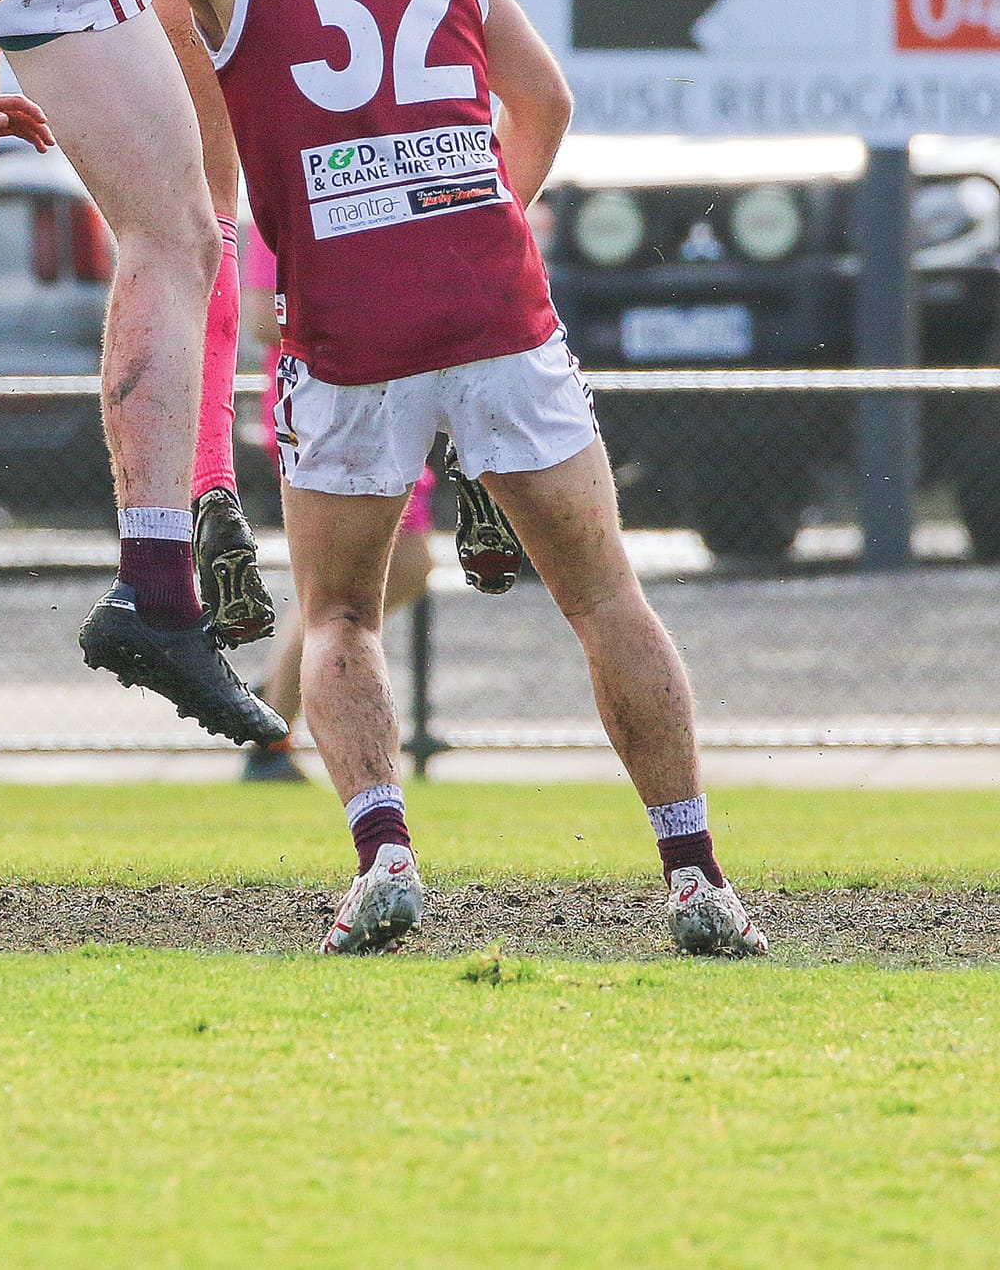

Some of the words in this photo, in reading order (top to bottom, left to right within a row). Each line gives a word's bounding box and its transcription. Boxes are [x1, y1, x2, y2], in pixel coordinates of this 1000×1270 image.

[572, 75, 688, 126] OUSE
[393, 131, 487, 161] RIGGING
[313, 177, 326, 191] &
[331, 164, 389, 187] CRANE
[394, 159, 433, 176] HIRE
[438, 154, 468, 171] PTY
[470, 152, 493, 165] LTD
[328, 195, 401, 225] mantra
